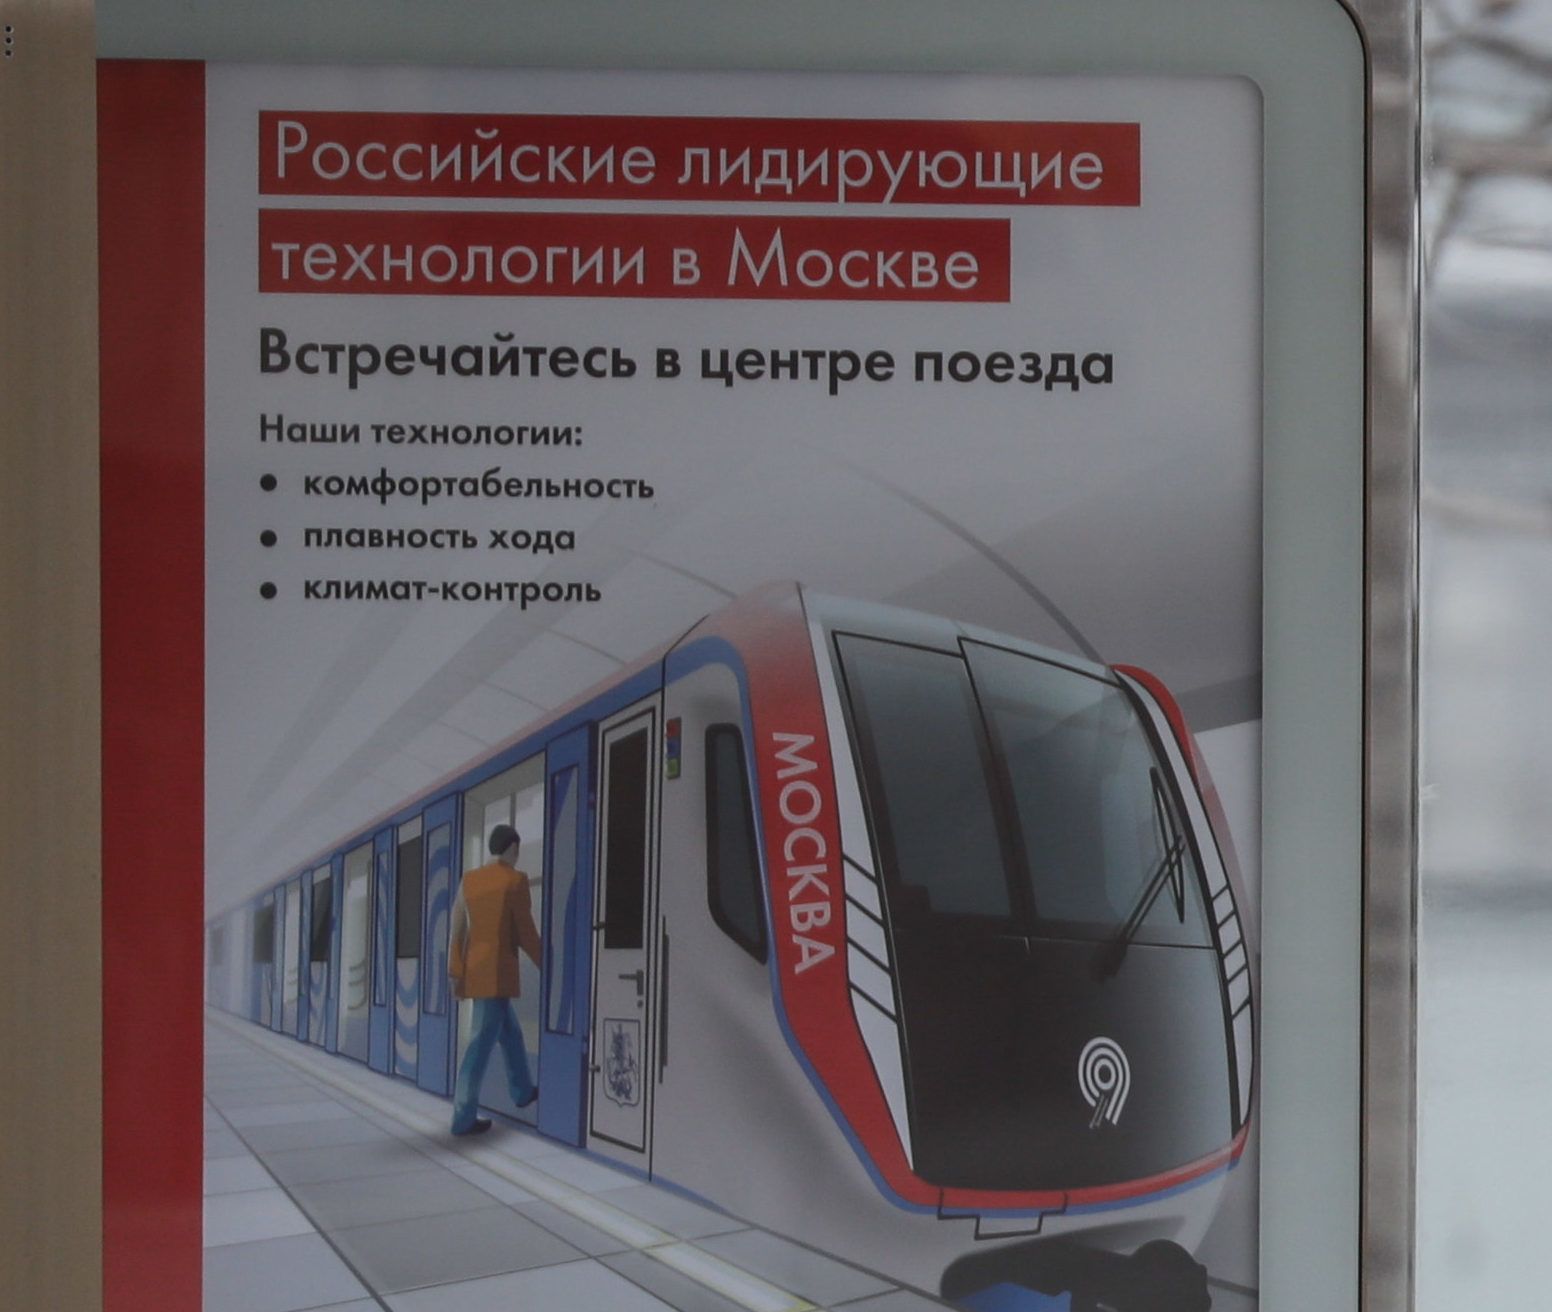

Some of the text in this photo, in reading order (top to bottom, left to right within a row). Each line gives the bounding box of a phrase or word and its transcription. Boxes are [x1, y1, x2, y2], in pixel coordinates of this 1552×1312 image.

[277, 121, 1104, 203] Российские лидирующие
[271, 227, 979, 289] технологии в Москве
[259, 327, 1114, 395] Встречайтесь в центре поезда
[259, 413, 583, 446] Наши технологии:
[304, 467, 655, 504] комфортабельность
[304, 527, 576, 554] плавность хода
[304, 578, 602, 610] климат-контроль
[772, 732, 835, 975] МОСКВА
